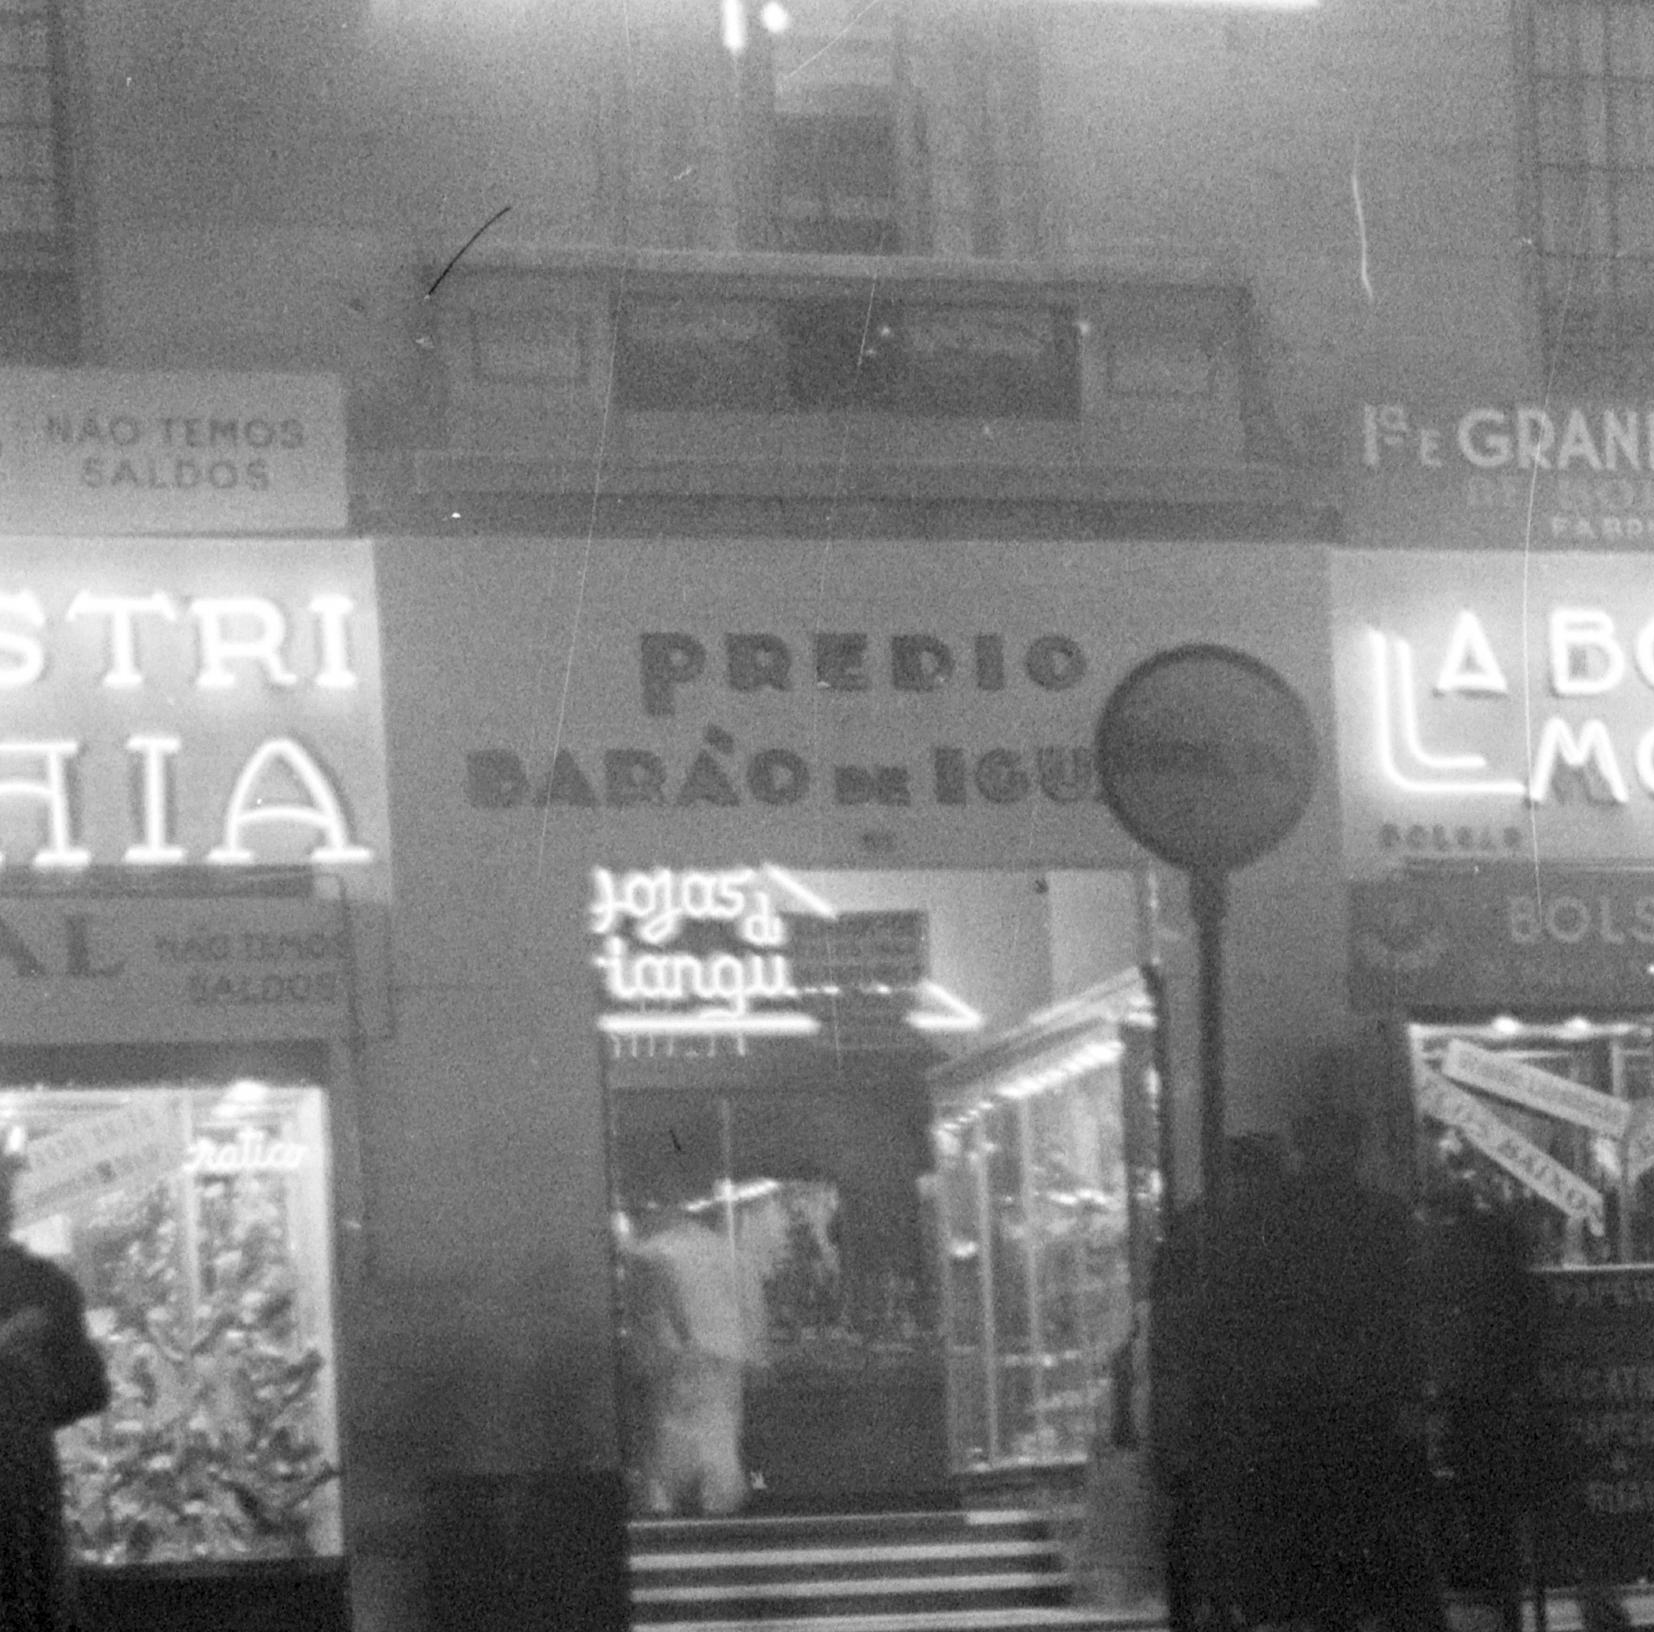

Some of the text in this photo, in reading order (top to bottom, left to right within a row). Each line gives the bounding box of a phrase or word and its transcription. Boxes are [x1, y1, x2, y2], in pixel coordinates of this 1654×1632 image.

[159, 416, 305, 449] TEMOS
[80, 454, 271, 491] SALDOS
[638, 631, 1085, 716] PREDIO
[185, 972, 338, 1005] SALDOS
